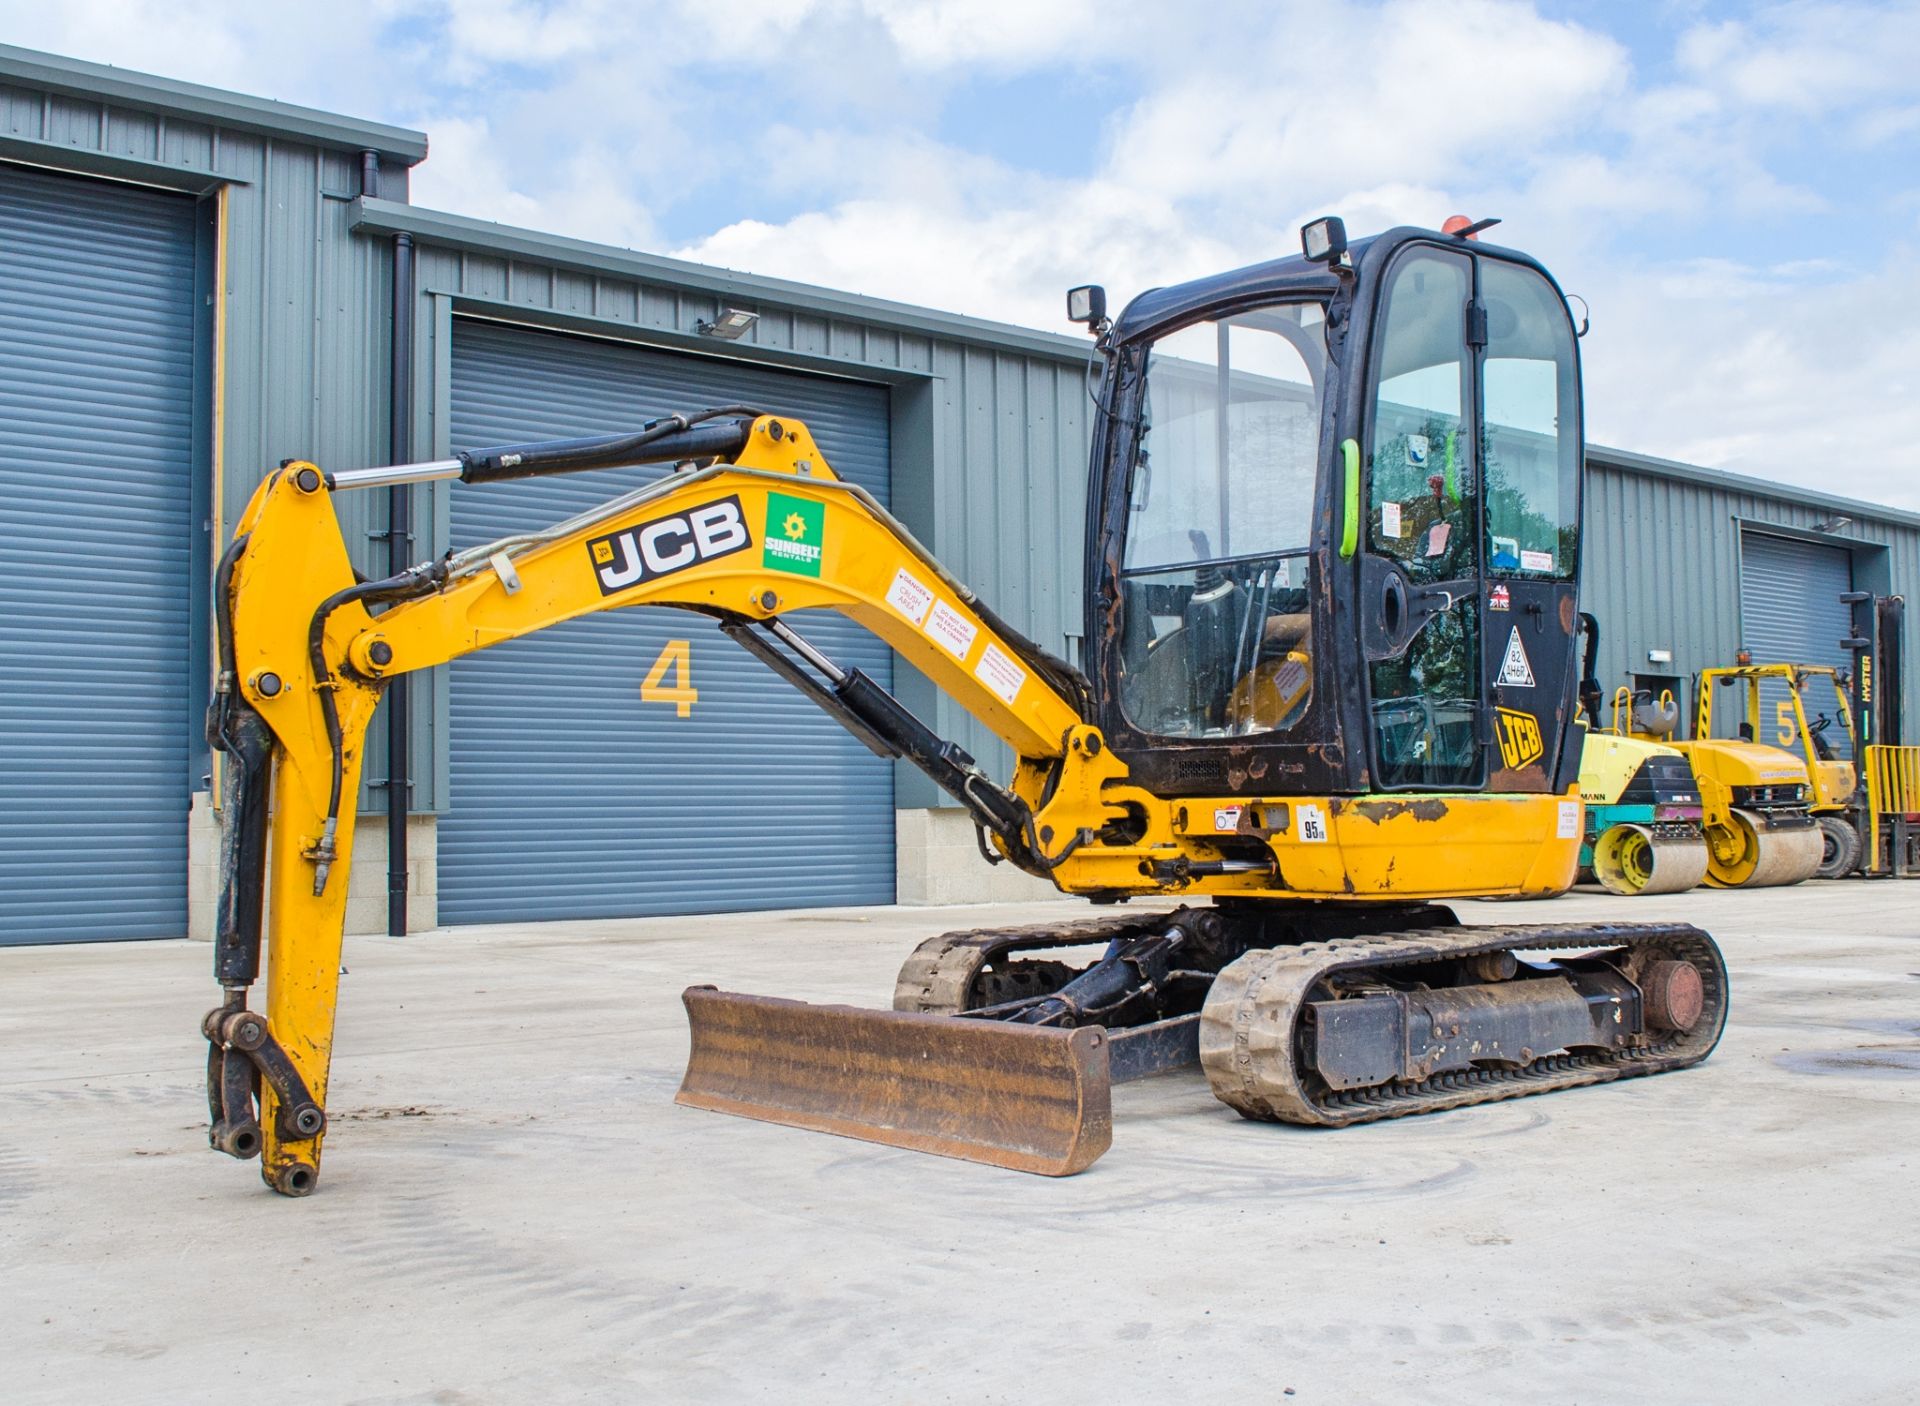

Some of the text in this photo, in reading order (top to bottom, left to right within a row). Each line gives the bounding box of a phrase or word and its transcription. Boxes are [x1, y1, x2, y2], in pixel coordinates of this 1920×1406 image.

[600, 502, 747, 589] JCB
[765, 537, 821, 559] SUNBELT
[772, 551, 812, 563] RENTALS
[899, 586, 922, 607] CRUSH
[903, 576, 927, 597] DANGER
[898, 595, 915, 612] AREA
[940, 609, 969, 633] DO NOT USE
[944, 618, 971, 642] EXCAVATOR
[947, 629, 963, 644] CRANE
[1511, 650, 1521, 663] 82
[641, 640, 698, 718] 4
[1862, 655, 1871, 702] HYSTER
[1777, 702, 1796, 747] 5
[1502, 714, 1540, 768] JCB
[1305, 821, 1318, 839] 95
